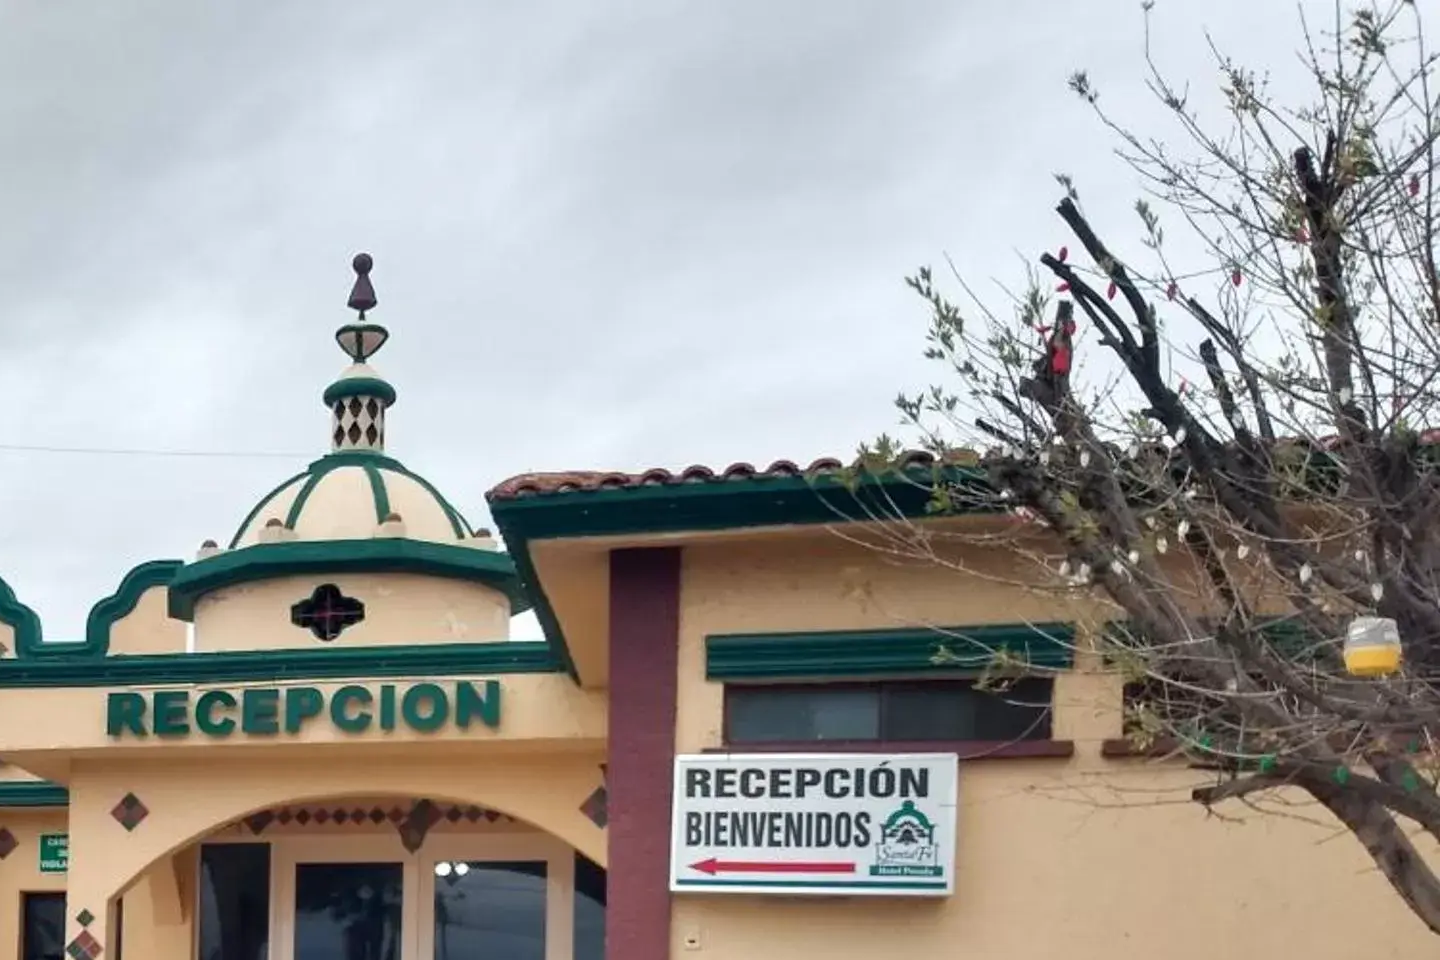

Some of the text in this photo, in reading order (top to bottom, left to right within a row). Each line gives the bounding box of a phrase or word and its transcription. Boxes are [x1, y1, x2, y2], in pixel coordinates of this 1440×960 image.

[107, 680, 500, 737] RECEPCION
[685, 761, 929, 798] RECEPCIÓN
[685, 811, 871, 848] BIENVENIDOS
